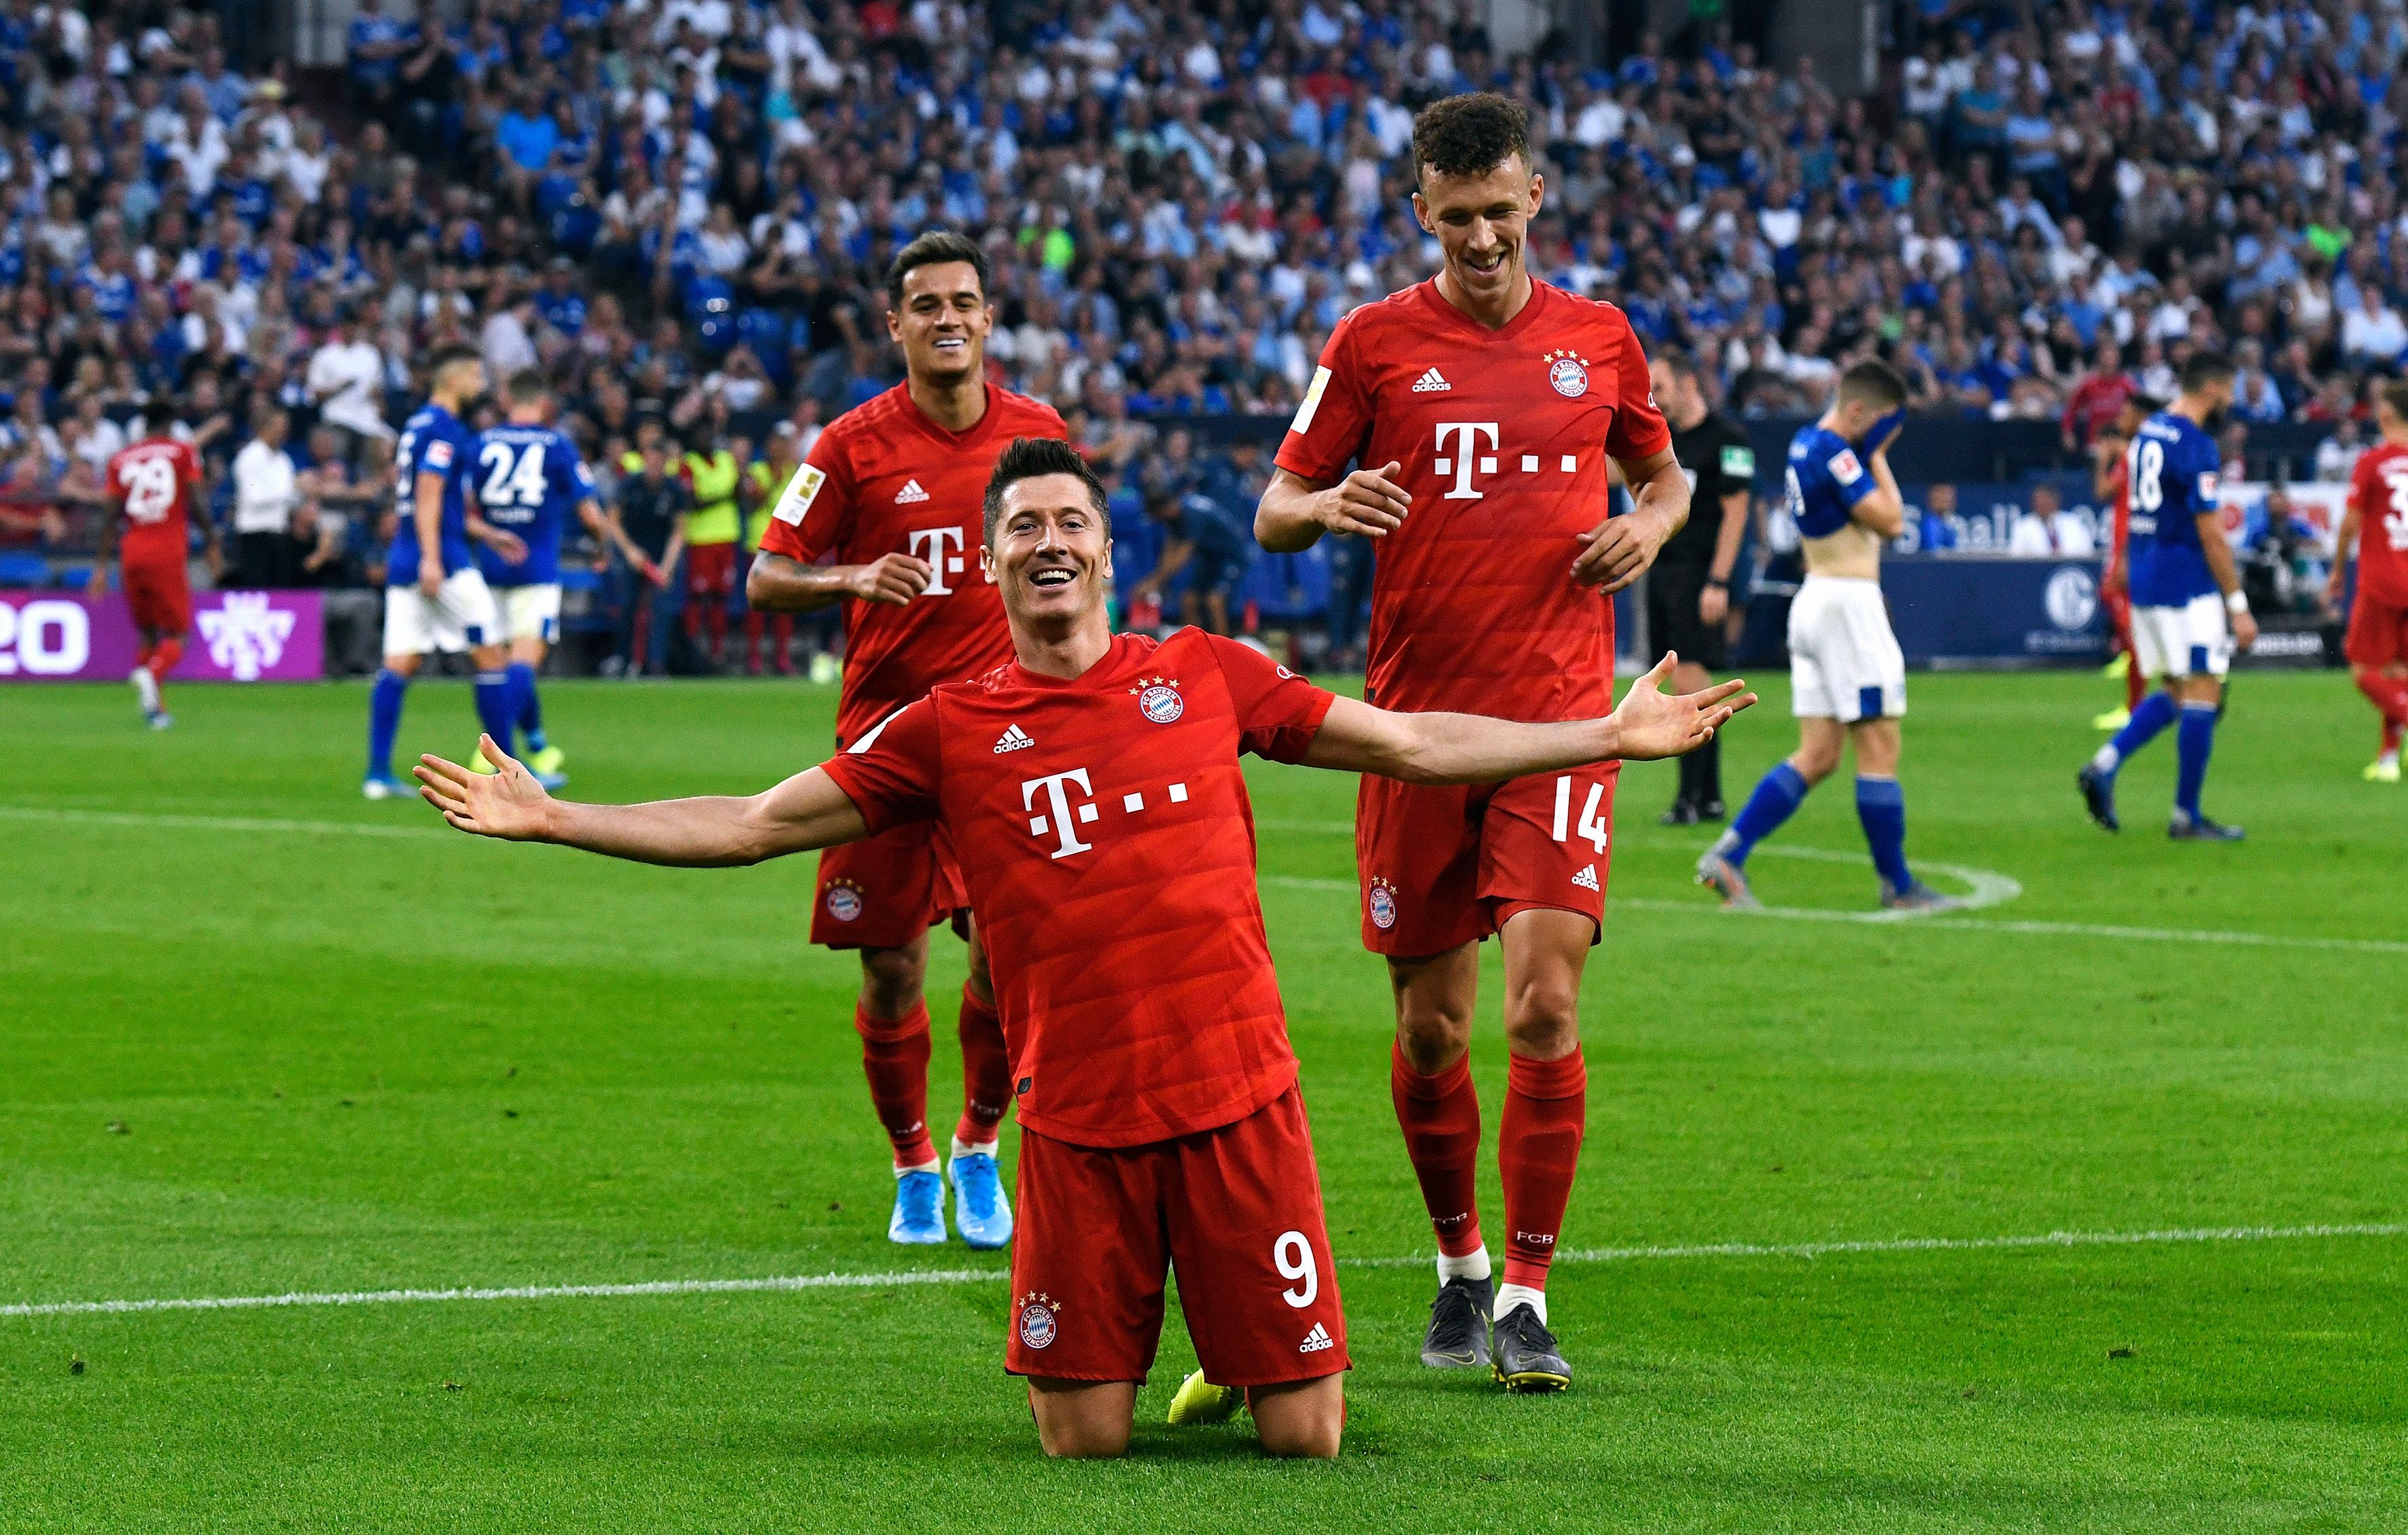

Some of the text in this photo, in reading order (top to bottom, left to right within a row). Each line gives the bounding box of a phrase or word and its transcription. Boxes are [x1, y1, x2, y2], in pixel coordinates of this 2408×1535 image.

[1412, 382, 1452, 393] adidas
[478, 442, 548, 508] 24
[118, 457, 177, 516] 29
[1142, 688, 1177, 706] FC BAYERN
[993, 738, 1035, 754] adidas
[1552, 775, 1607, 855] 14
[1571, 876, 1600, 892] adidas
[1516, 1231, 1554, 1244] FCB
[1274, 1230, 1319, 1309] 9
[1024, 1307, 1053, 1325] FC BAYERN
[1299, 1338, 1334, 1353] adidas
